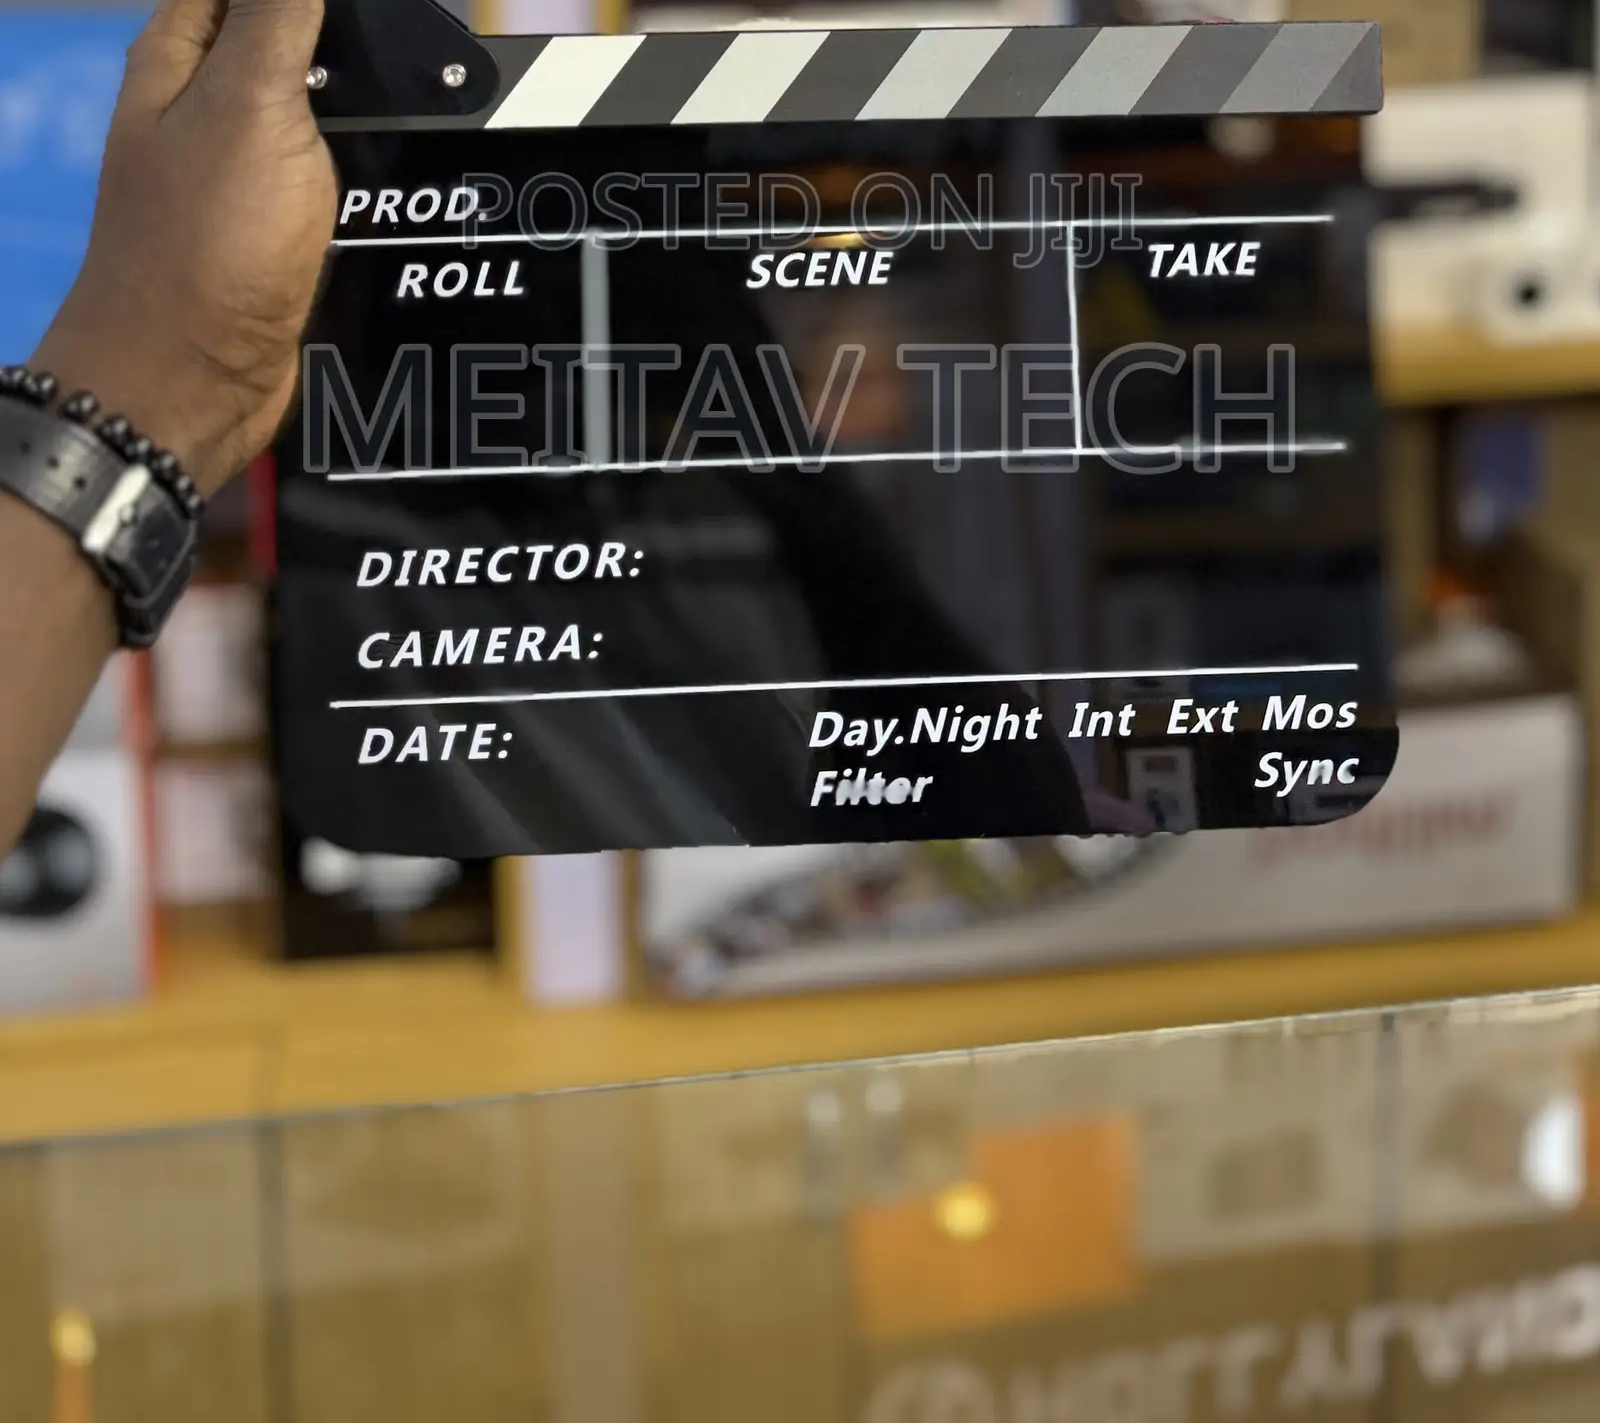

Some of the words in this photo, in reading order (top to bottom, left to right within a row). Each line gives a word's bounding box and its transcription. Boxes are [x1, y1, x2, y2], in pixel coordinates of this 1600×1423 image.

[340, 186, 487, 225] PROD.
[397, 260, 525, 298] ROLL
[745, 251, 895, 289] SCENE
[1148, 241, 1261, 278] TAKE
[356, 541, 645, 588] DIRECTOR:
[357, 624, 604, 669] CAMERA:
[1067, 701, 1136, 740] Int
[1166, 698, 1239, 736] Ext
[1261, 694, 1359, 731] Mos
[357, 722, 513, 764] DATE:
[1254, 751, 1360, 798] Sync
